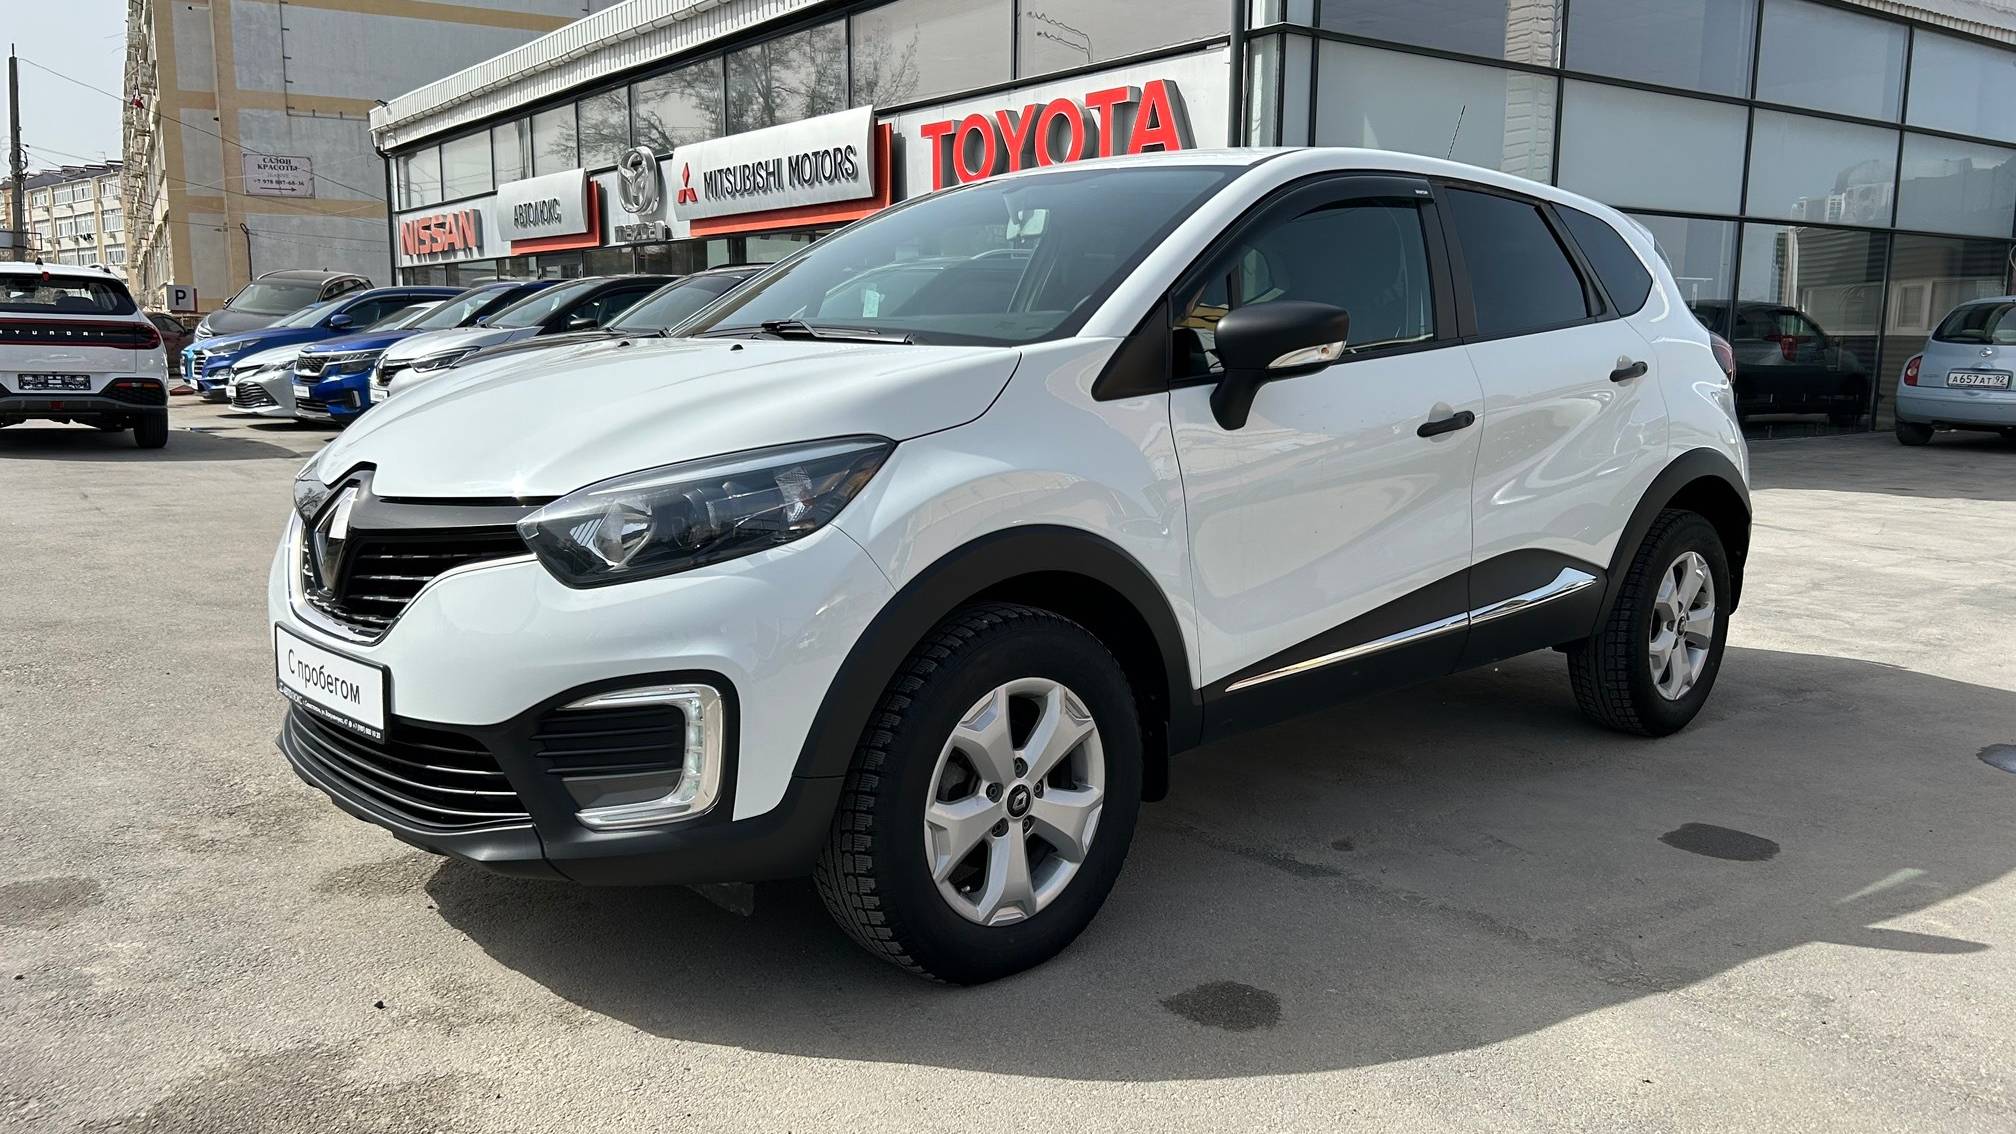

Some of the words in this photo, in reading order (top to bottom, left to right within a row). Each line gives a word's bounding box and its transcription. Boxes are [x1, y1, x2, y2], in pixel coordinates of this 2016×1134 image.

[920, 79, 1183, 190] TOYOTA
[703, 157, 784, 200] MITSUBISHI
[788, 144, 858, 188] MOTORS
[401, 208, 478, 256] NISSAN
[513, 197, 562, 227] АВТОЛЮКС
[288, 648, 295, 674] С
[297, 659, 361, 705] пробегом
